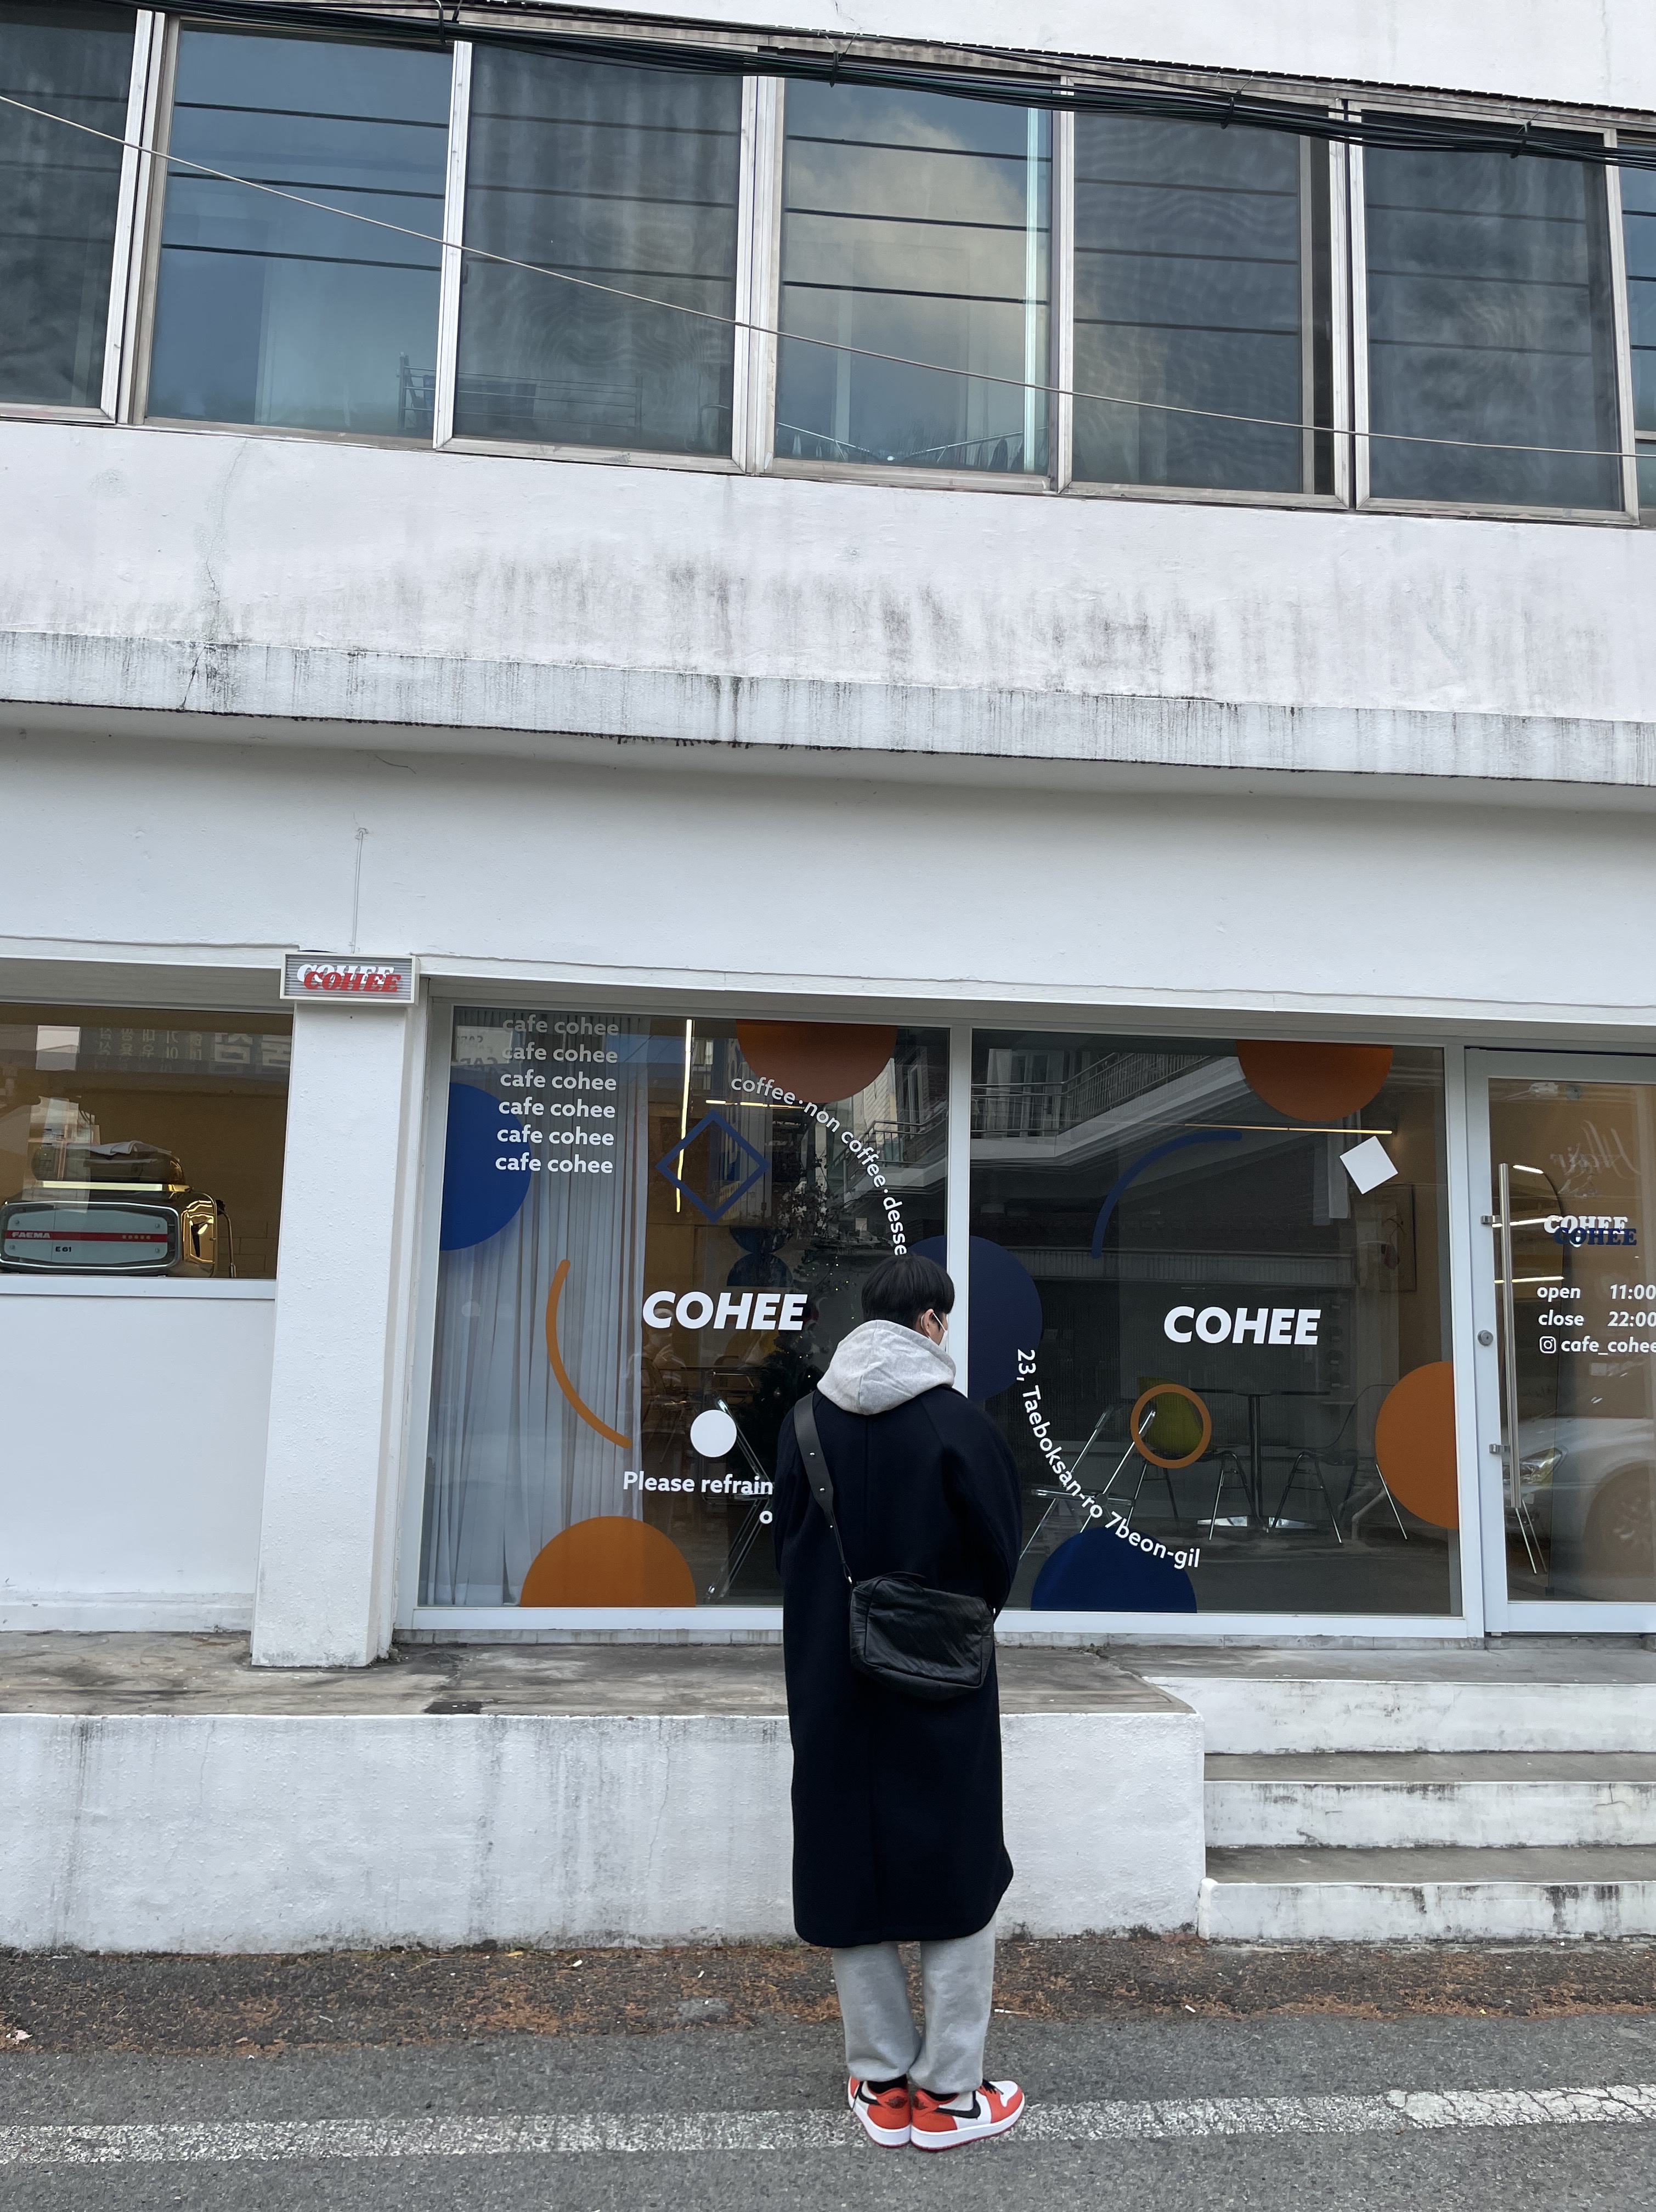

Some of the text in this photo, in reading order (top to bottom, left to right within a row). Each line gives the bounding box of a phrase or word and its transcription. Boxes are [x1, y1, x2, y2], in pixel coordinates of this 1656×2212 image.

[304, 972, 402, 992] COHEE
[503, 1014, 619, 1035] cafe cohee
[502, 1042, 618, 1063] cafe cohee
[500, 1069, 617, 1090] cafe cohee
[499, 1097, 615, 1118] cafe cohee
[497, 1125, 614, 1146] cafe cohee
[495, 1152, 613, 1173] cafe cohee
[731, 1077, 907, 1256] coffee non coffee desse
[1553, 1227, 1637, 1246] COHEE
[1537, 1284, 1656, 1302] open 11:00
[643, 1291, 807, 1331] COHEE
[1538, 1309, 1656, 1327] close 22:00
[1164, 1306, 1321, 1345] COHEE
[1561, 1335, 1656, 1355] cafe_cohee
[1016, 1349, 1200, 1570] 23, Taeboksan-ro 7beon-gil
[623, 1471, 773, 1495] Please refrain
